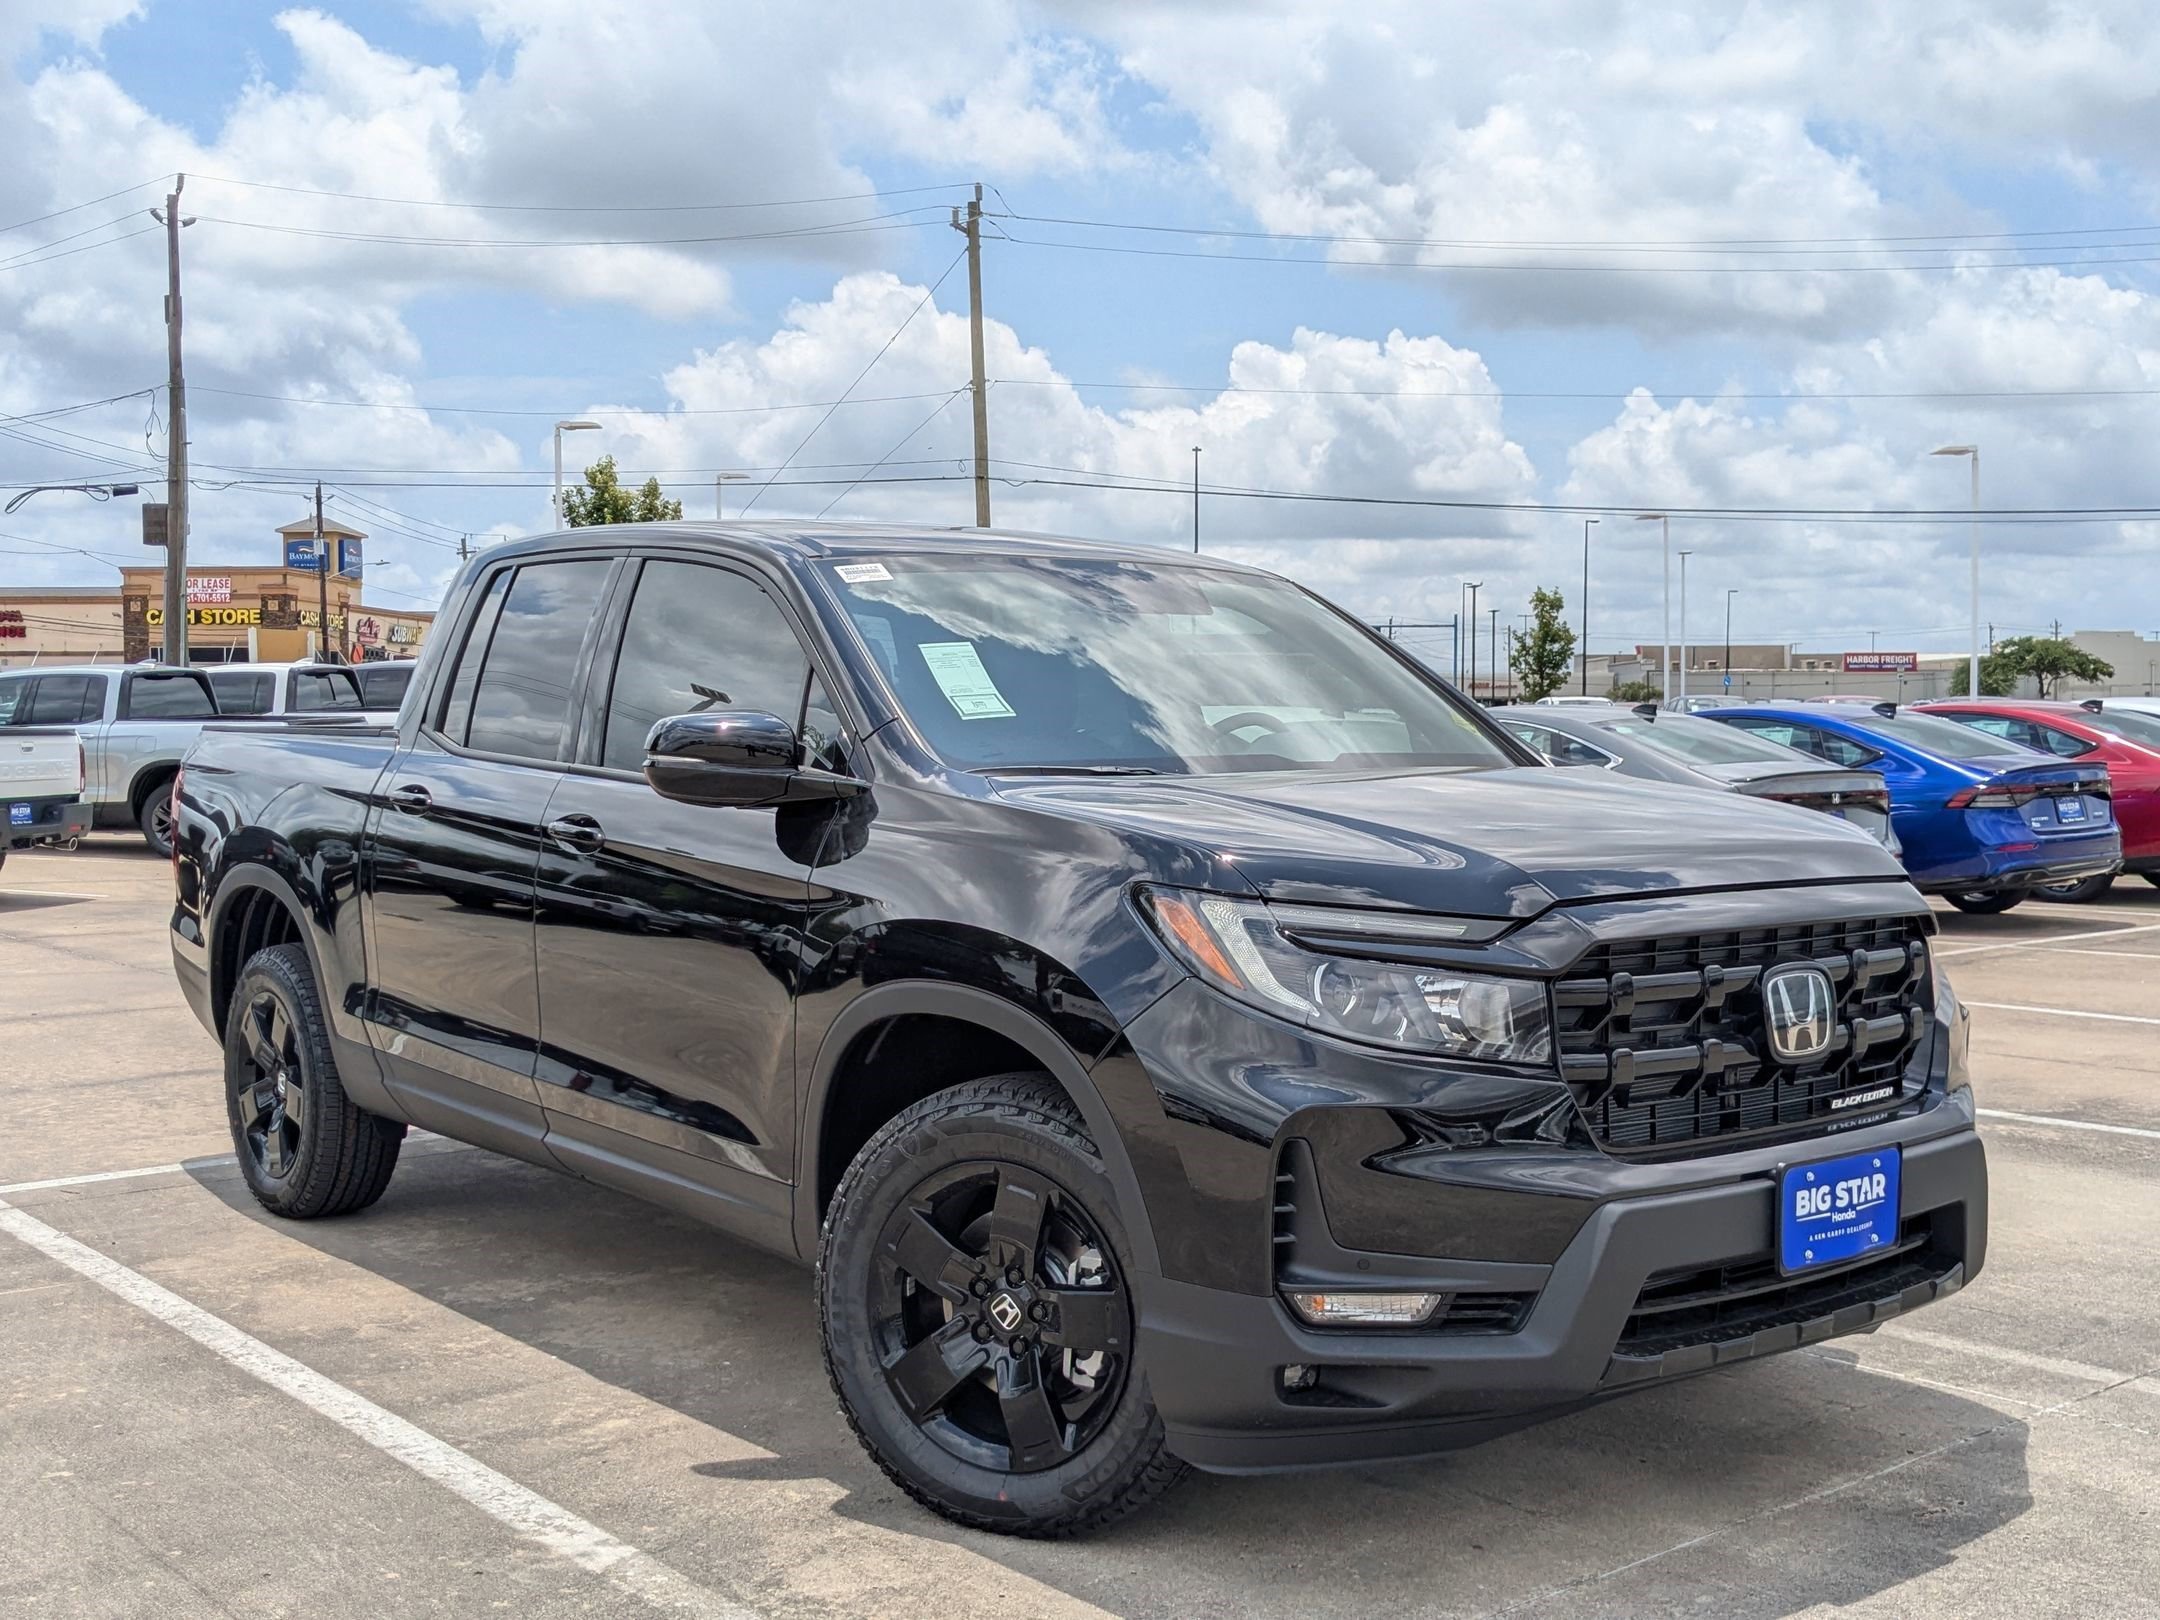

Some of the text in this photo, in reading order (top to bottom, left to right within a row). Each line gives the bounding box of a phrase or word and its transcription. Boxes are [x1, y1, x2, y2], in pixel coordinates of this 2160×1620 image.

[288, 552, 320, 560] BAYMO
[186, 578, 230, 589] OR LEASE
[186, 593, 231, 603] 1-701-5512
[200, 608, 261, 625] STORE
[300, 610, 345, 630] CASH TORE
[1846, 655, 1915, 664] HARBOR FREIGHT
[1831, 1086, 1894, 1109] BLACK EDITION
[1795, 1173, 1886, 1217] BIG STAR
[1831, 1209, 1857, 1223] Honda
